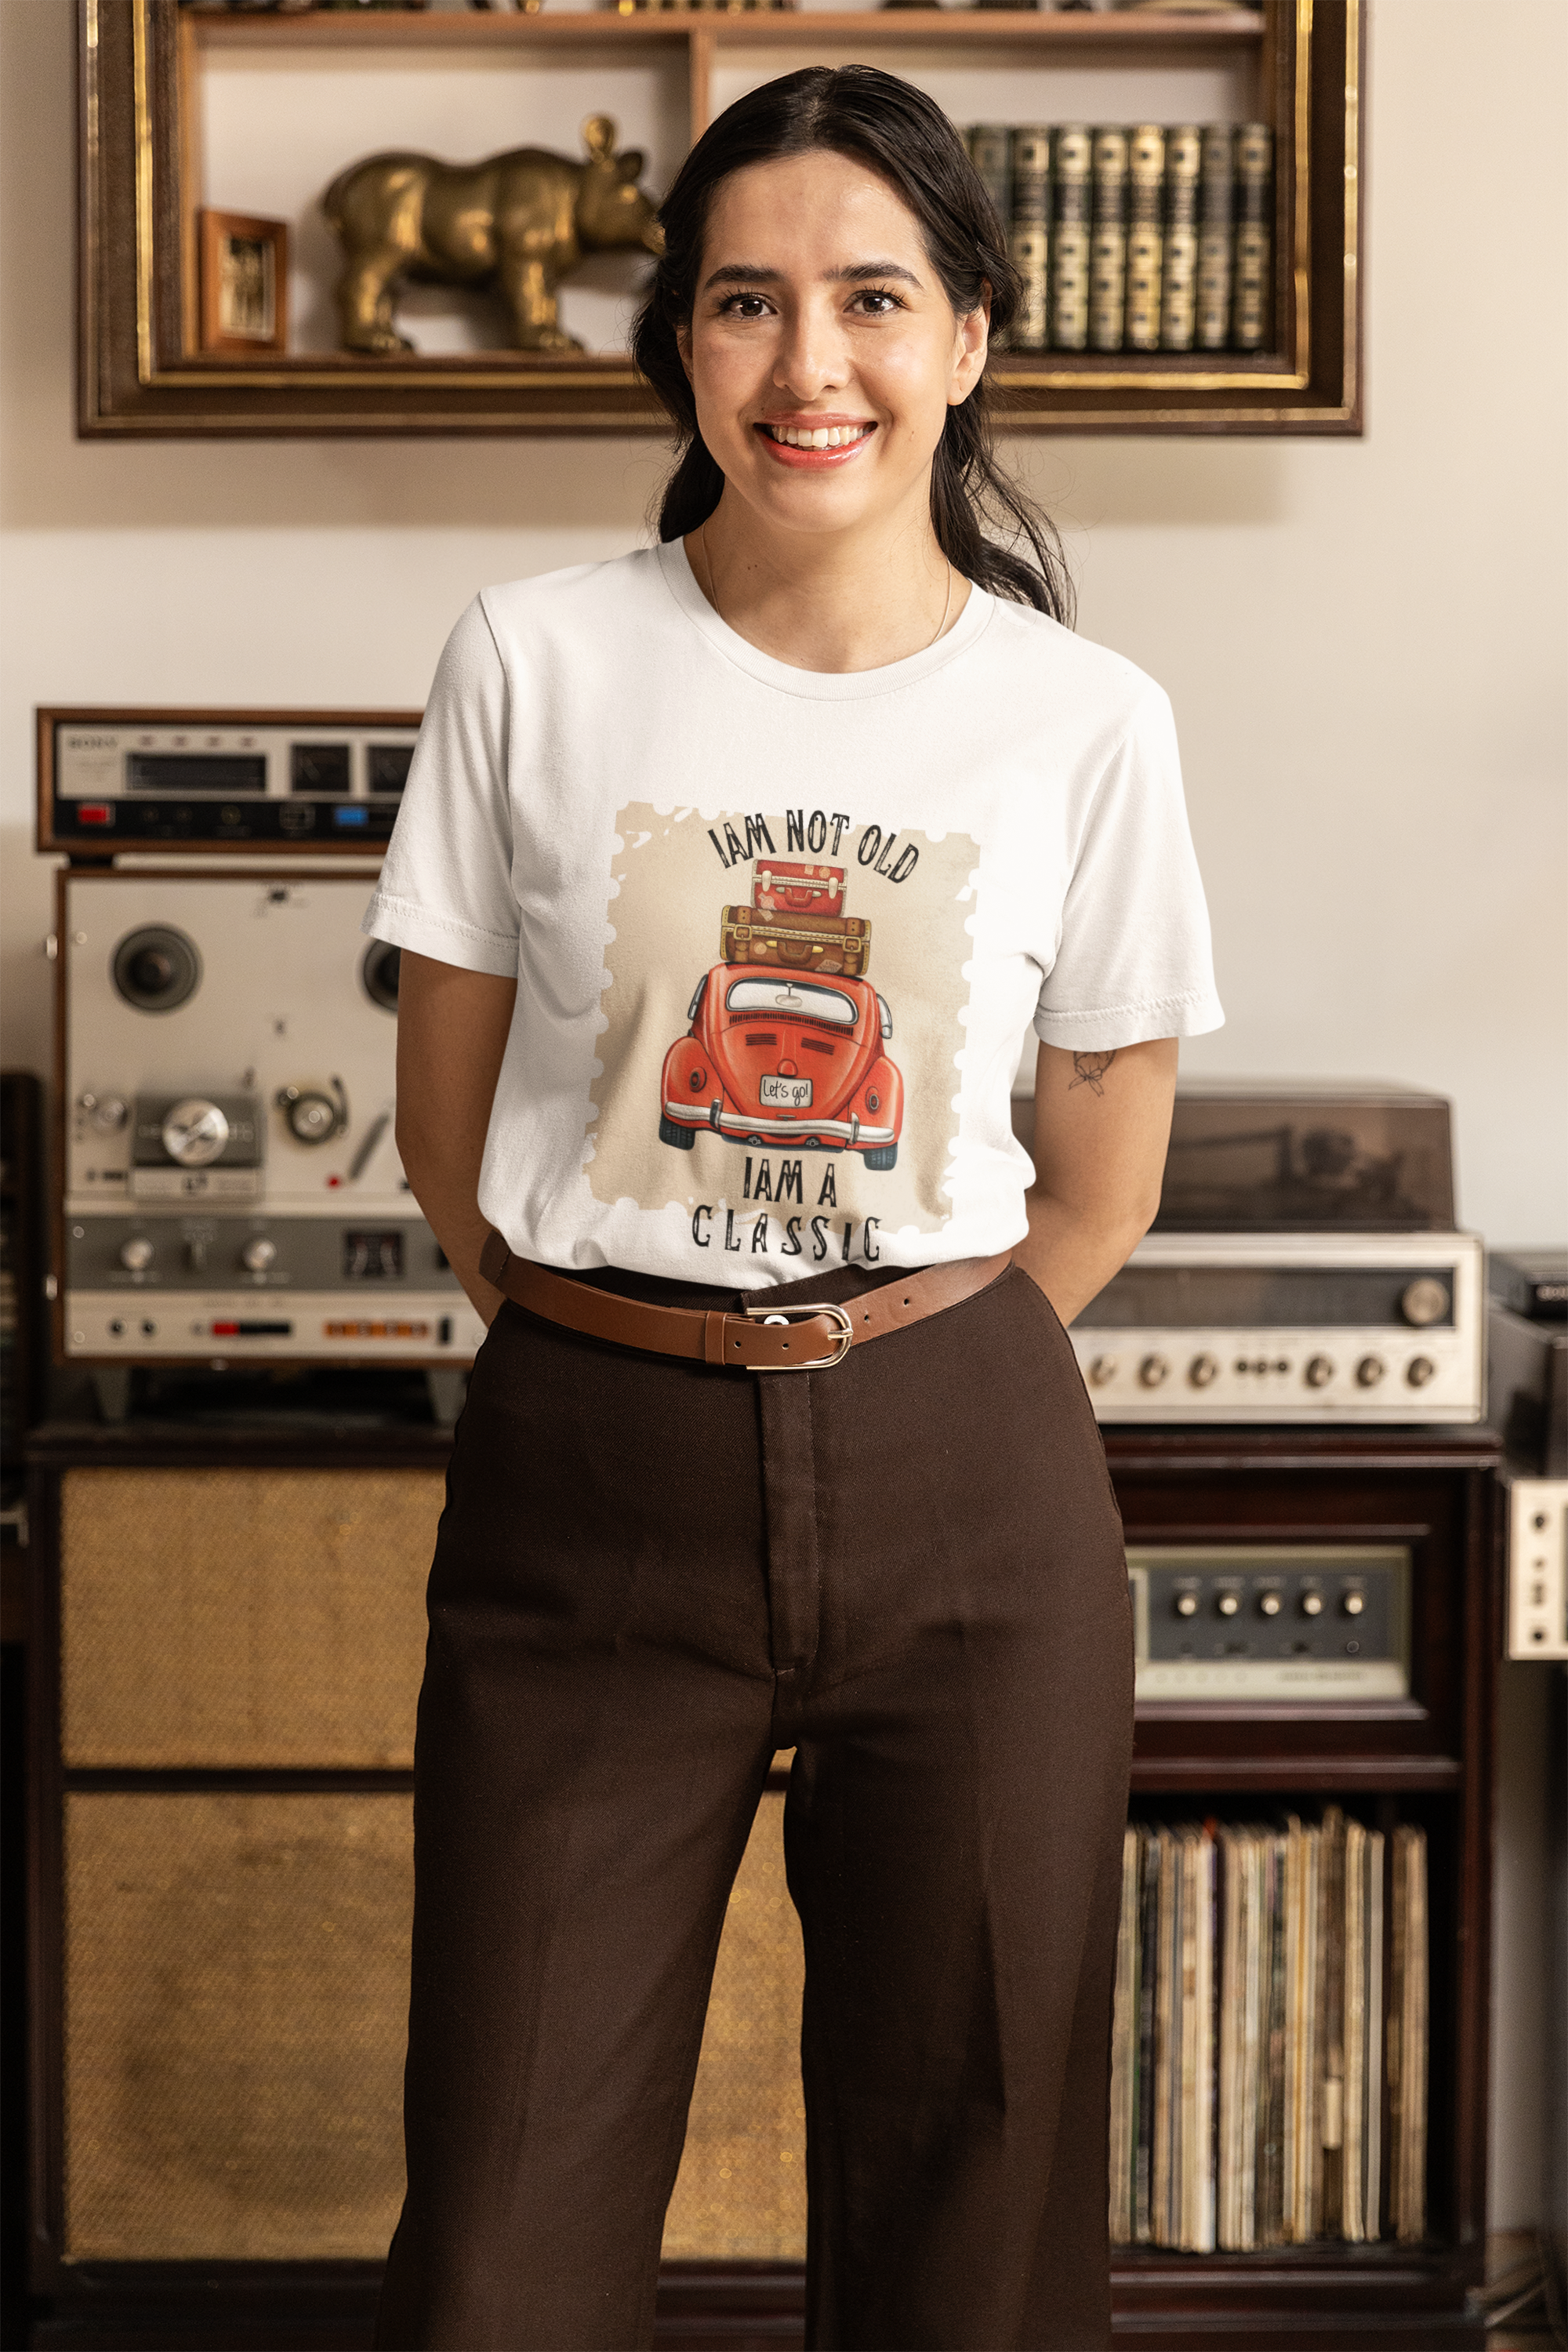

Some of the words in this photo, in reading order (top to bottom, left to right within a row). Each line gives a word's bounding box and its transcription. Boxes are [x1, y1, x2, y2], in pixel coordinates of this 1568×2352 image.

[786, 808, 851, 857] NOT
[857, 824, 920, 884] OLD
[763, 1079, 789, 1099] Let's
[792, 1083, 808, 1107] go!
[816, 1163, 837, 1208] A
[691, 1204, 883, 1262] CLASSIC
